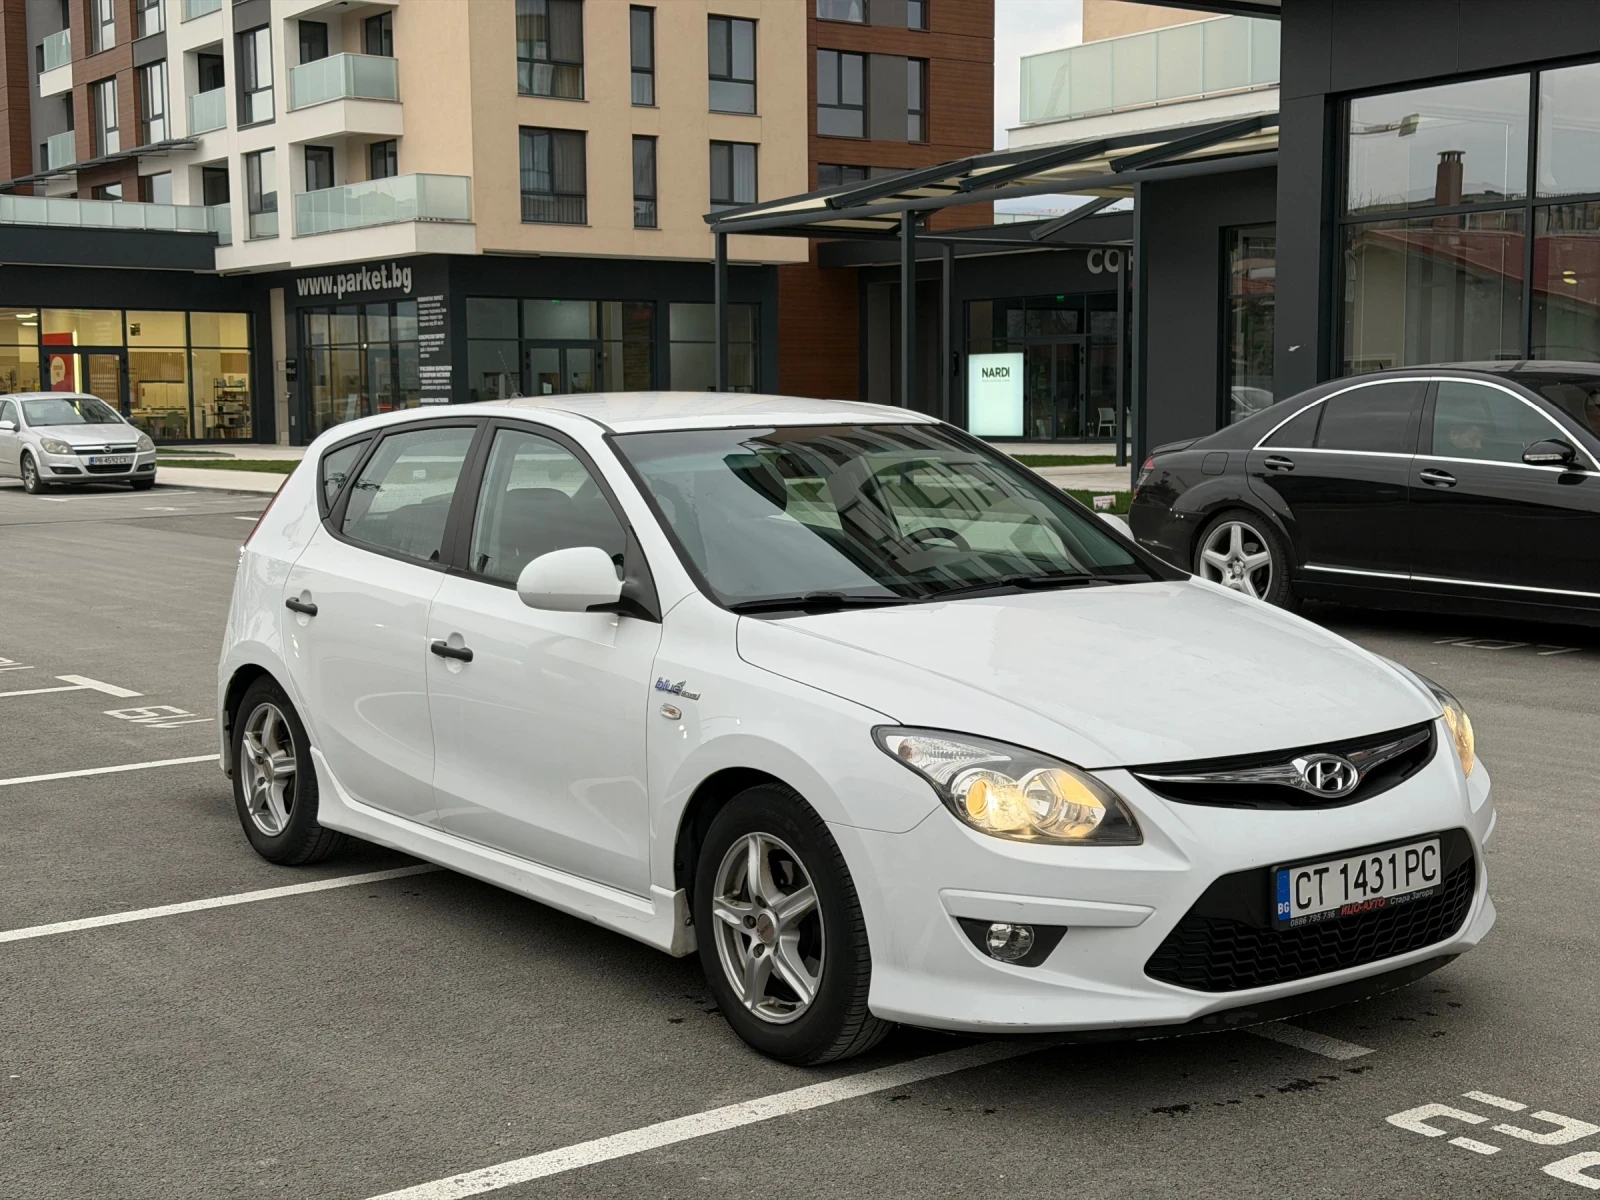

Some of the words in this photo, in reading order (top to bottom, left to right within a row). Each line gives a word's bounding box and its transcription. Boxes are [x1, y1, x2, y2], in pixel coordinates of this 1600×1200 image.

[297, 262, 412, 299] www.parket.bg
[981, 366, 1011, 378] NARDI
[655, 677, 682, 695] blue
[1295, 866, 1330, 910] CT
[1339, 853, 1397, 901] 1431
[1405, 845, 1437, 887] PC
[1277, 902, 1290, 915] BG
[1290, 914, 1307, 928] 0886
[1308, 912, 1321, 924] 795
[1390, 894, 1410, 906] Стара
[1411, 888, 1434, 902] Загора
